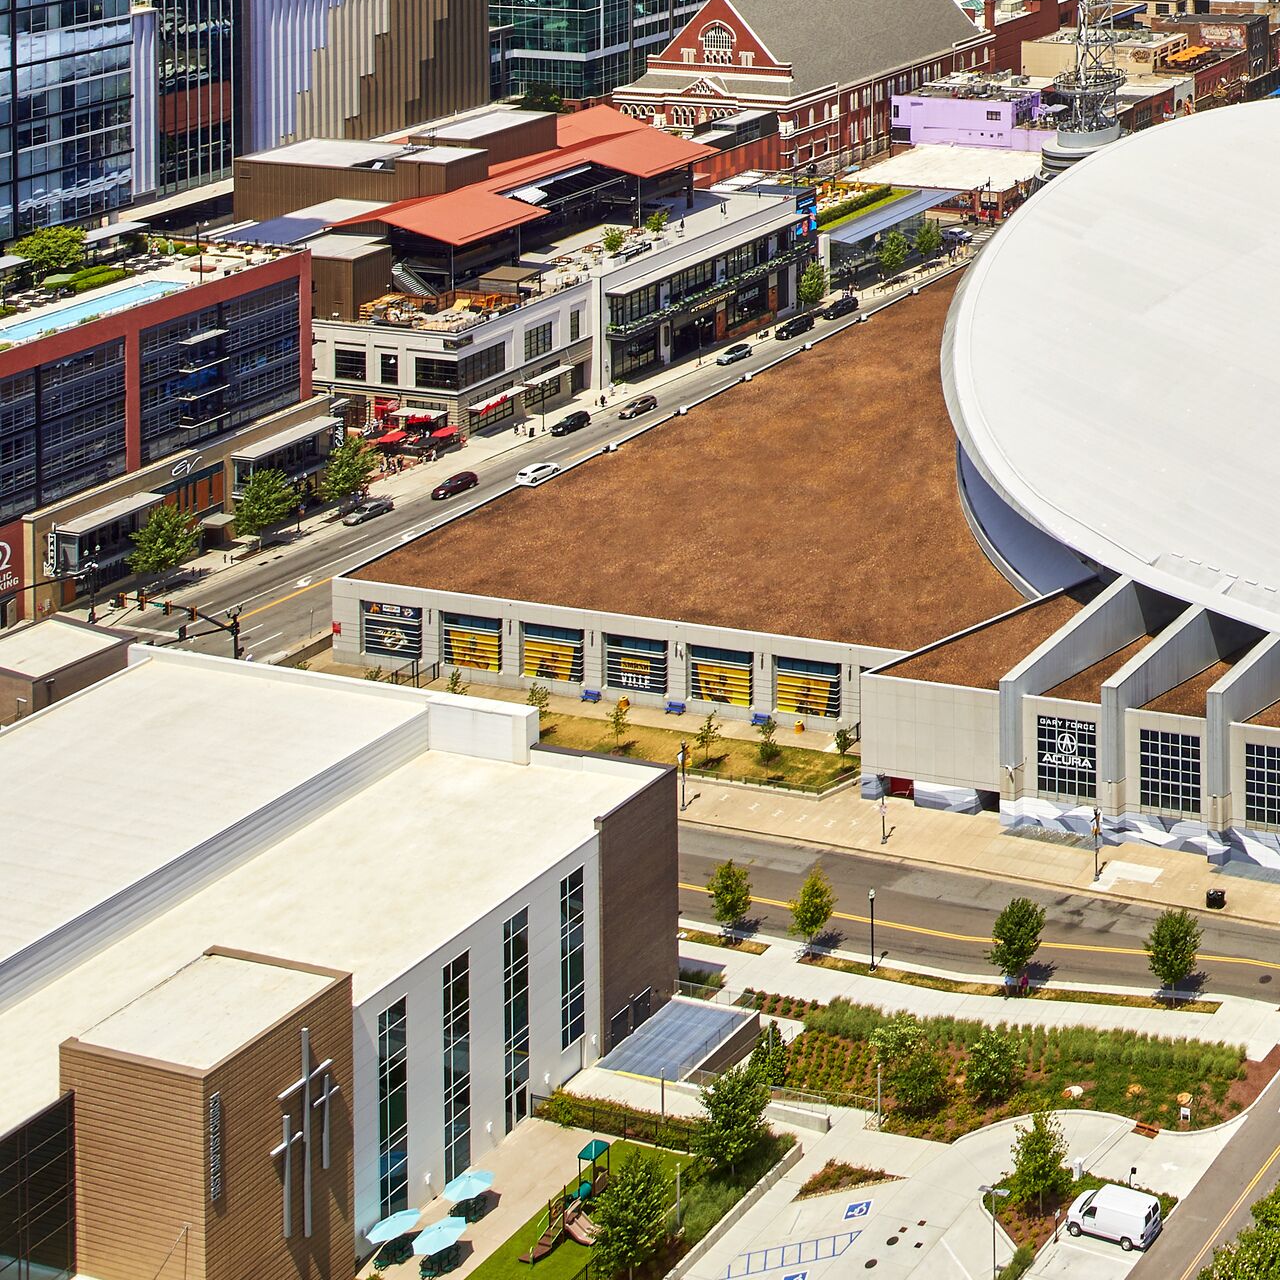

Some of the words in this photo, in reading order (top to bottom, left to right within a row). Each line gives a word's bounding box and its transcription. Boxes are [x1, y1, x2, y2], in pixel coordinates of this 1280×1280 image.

[1040, 717, 1063, 727] GARY
[1066, 721, 1095, 731] FORCE
[1042, 754, 1093, 768] ACURA
[209, 1091, 221, 1132] CHURCH
[209, 1132, 221, 1172] BAPTIST
[210, 1172, 221, 1201] FIRST
